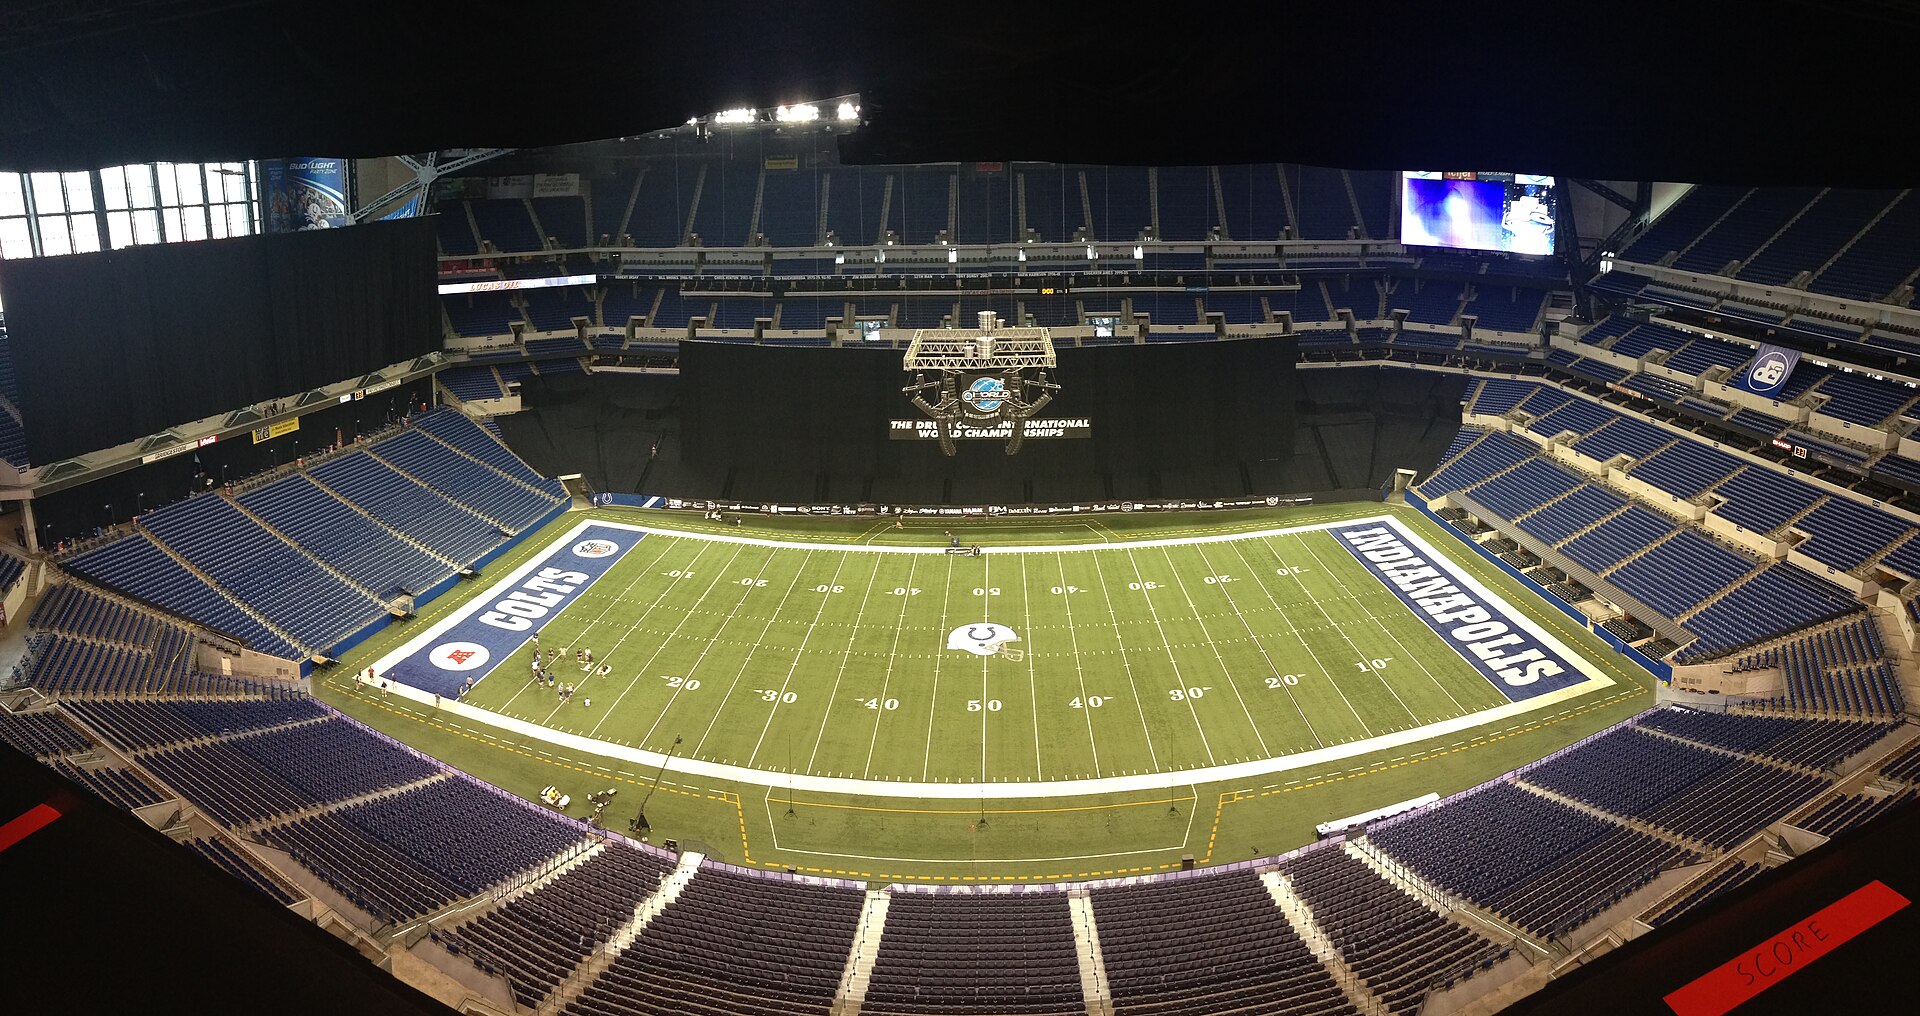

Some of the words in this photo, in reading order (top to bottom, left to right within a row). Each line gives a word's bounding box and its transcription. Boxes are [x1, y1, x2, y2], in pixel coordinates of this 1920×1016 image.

[290, 162, 308, 170] BUD
[469, 282, 500, 292] LUCAS
[502, 280, 520, 289] OIL
[890, 420, 913, 430] THE
[916, 420, 952, 430] DRU
[997, 419, 1090, 429] INTRNATIONAL
[918, 429, 962, 438] WOLD
[964, 428, 1065, 438] CHAMPINSHIPS
[1772, 439, 1792, 449] SHARP
[668, 569, 696, 579] 10
[1276, 566, 1303, 577] 10
[741, 577, 769, 588] 20
[1203, 574, 1233, 585] 20
[816, 584, 845, 594] 30
[972, 587, 1001, 596] 50
[1050, 586, 1079, 595] 40
[1128, 581, 1157, 591] 30
[893, 587, 922, 597] 40
[477, 566, 590, 632] COLTS
[1341, 526, 1566, 687] INDIANAPOLIS
[1354, 658, 1388, 673] 10
[667, 676, 701, 691] 20
[1264, 674, 1299, 689] 20
[761, 690, 798, 704] 30
[1169, 686, 1204, 701] 30
[864, 698, 899, 711] 40
[967, 699, 1002, 713] 50
[1068, 695, 1104, 709] 40
[1736, 920, 1830, 987] SCORE
